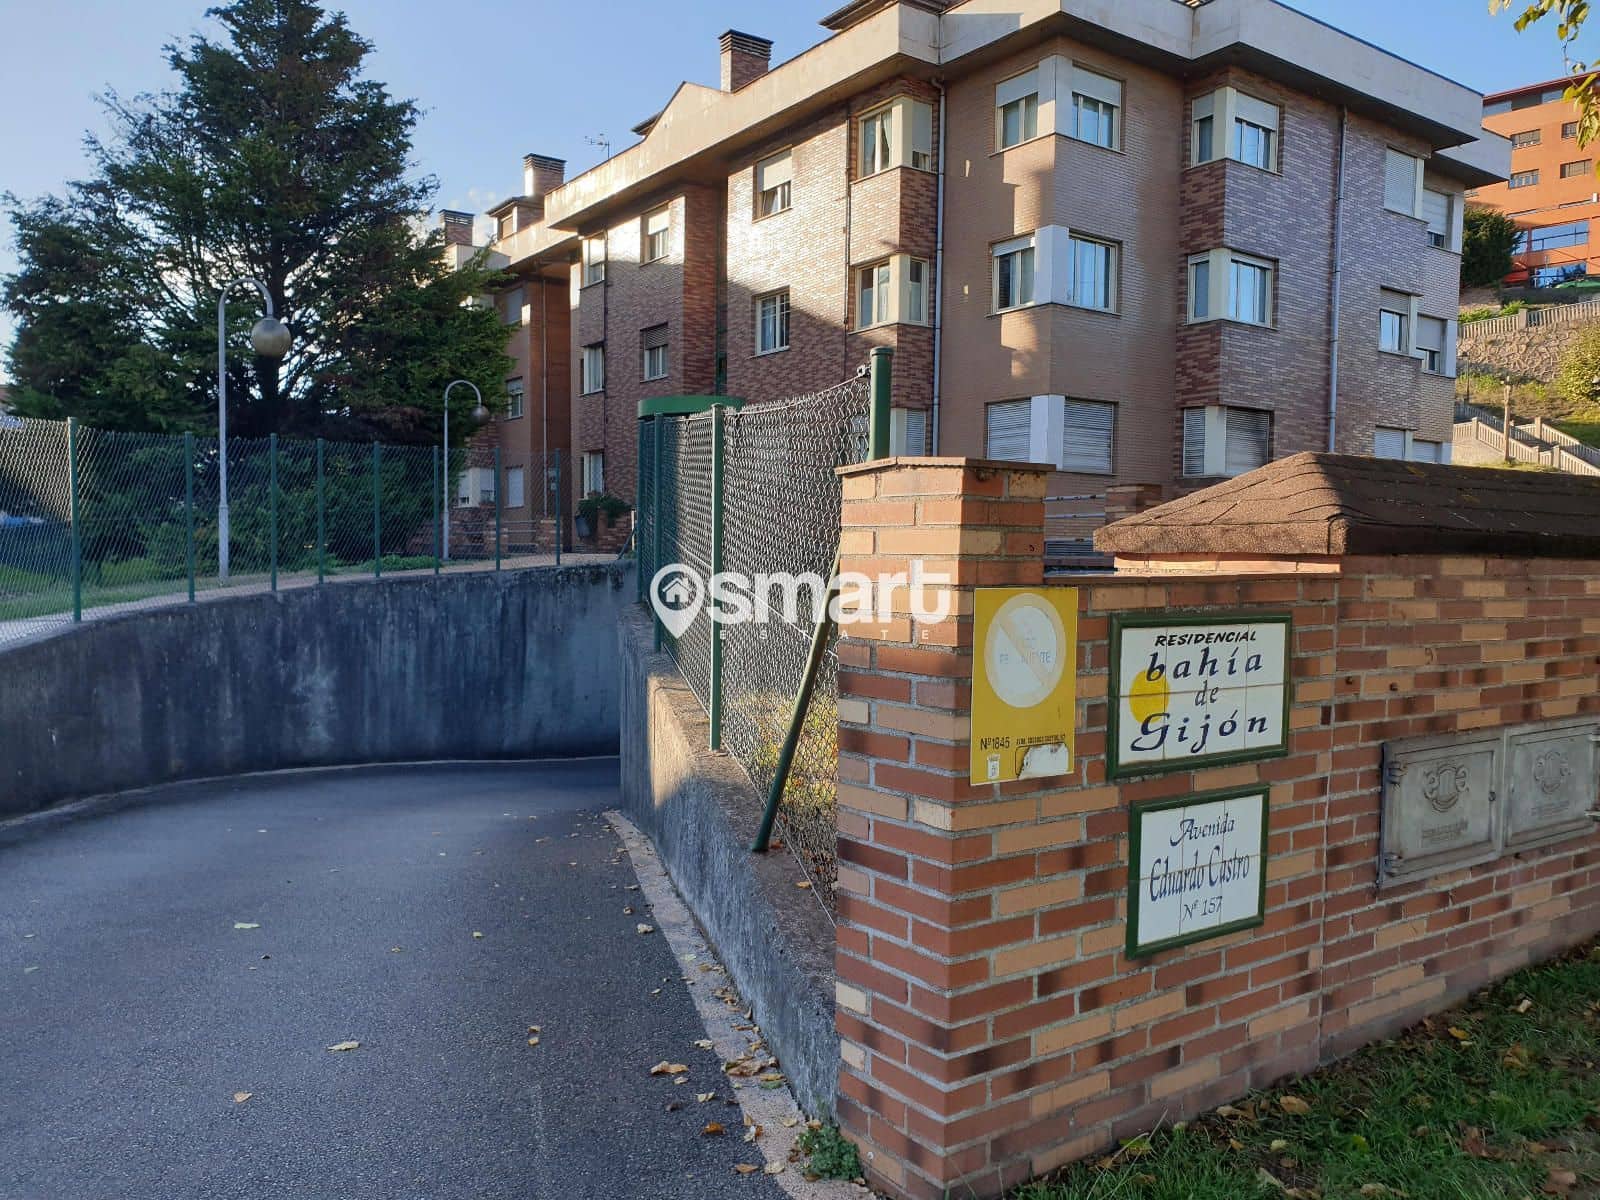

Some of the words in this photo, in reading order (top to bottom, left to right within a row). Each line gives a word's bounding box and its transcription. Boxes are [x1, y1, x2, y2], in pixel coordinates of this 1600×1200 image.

[1154, 631, 1257, 647] RESIDENCIAL
[1146, 647, 1263, 682] bahía
[1194, 680, 1220, 706] de
[1130, 710, 1268, 753] Gijón
[1169, 812, 1235, 847] Avenida
[1149, 848, 1205, 902] Eduardo
[1208, 845, 1250, 888] Castro
[1200, 896, 1223, 916] 157
